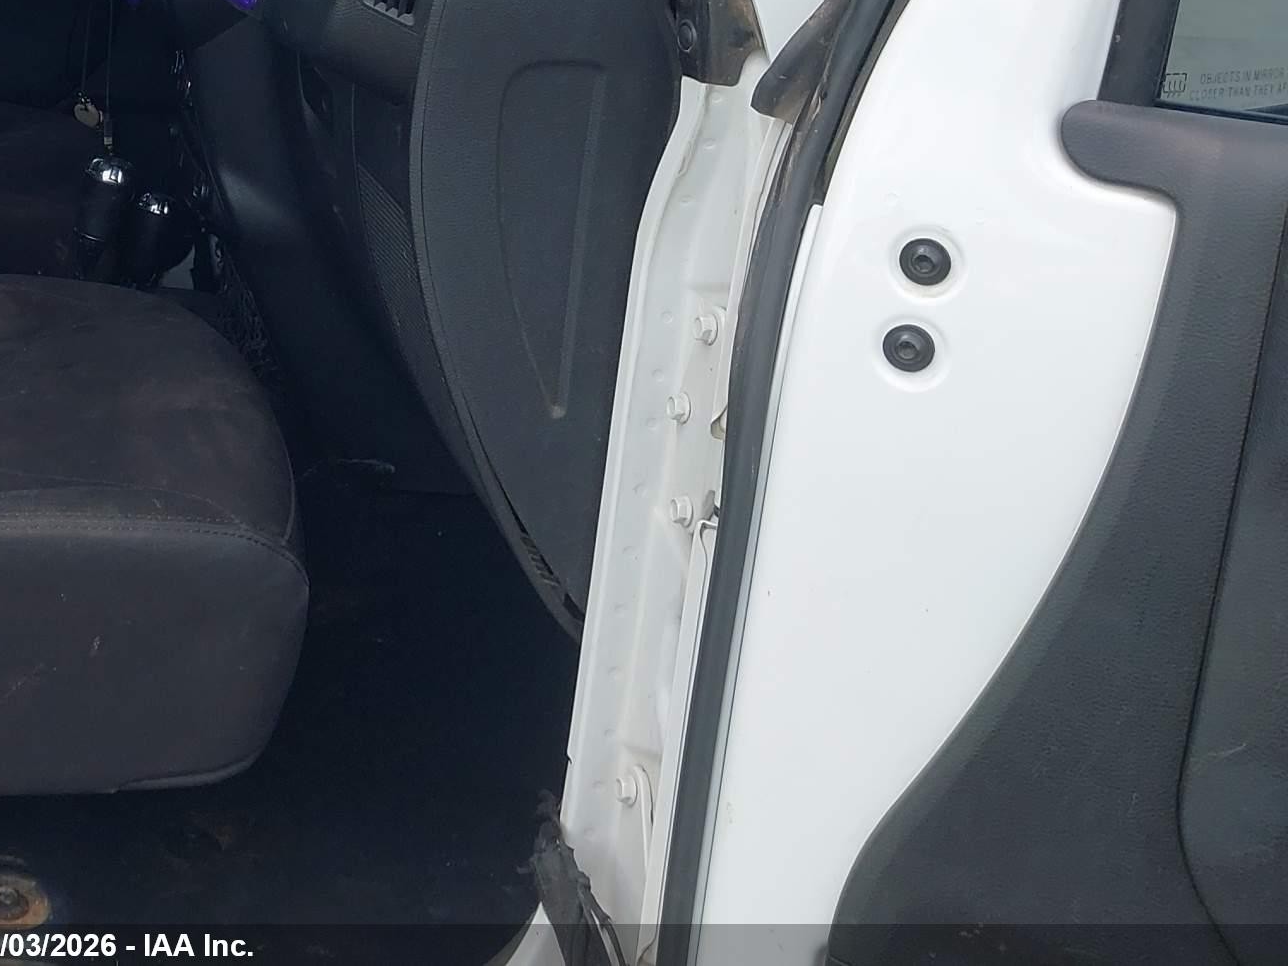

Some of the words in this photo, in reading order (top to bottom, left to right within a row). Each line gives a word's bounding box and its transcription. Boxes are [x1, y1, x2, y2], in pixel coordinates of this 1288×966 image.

[1200, 71, 1241, 84] OBJECTS
[1243, 69, 1252, 82] IN
[1254, 67, 1285, 81] MIRROR
[1189, 87, 1225, 102] CLOSER
[1228, 85, 1251, 99] THAN
[1254, 82, 1274, 97] THEY
